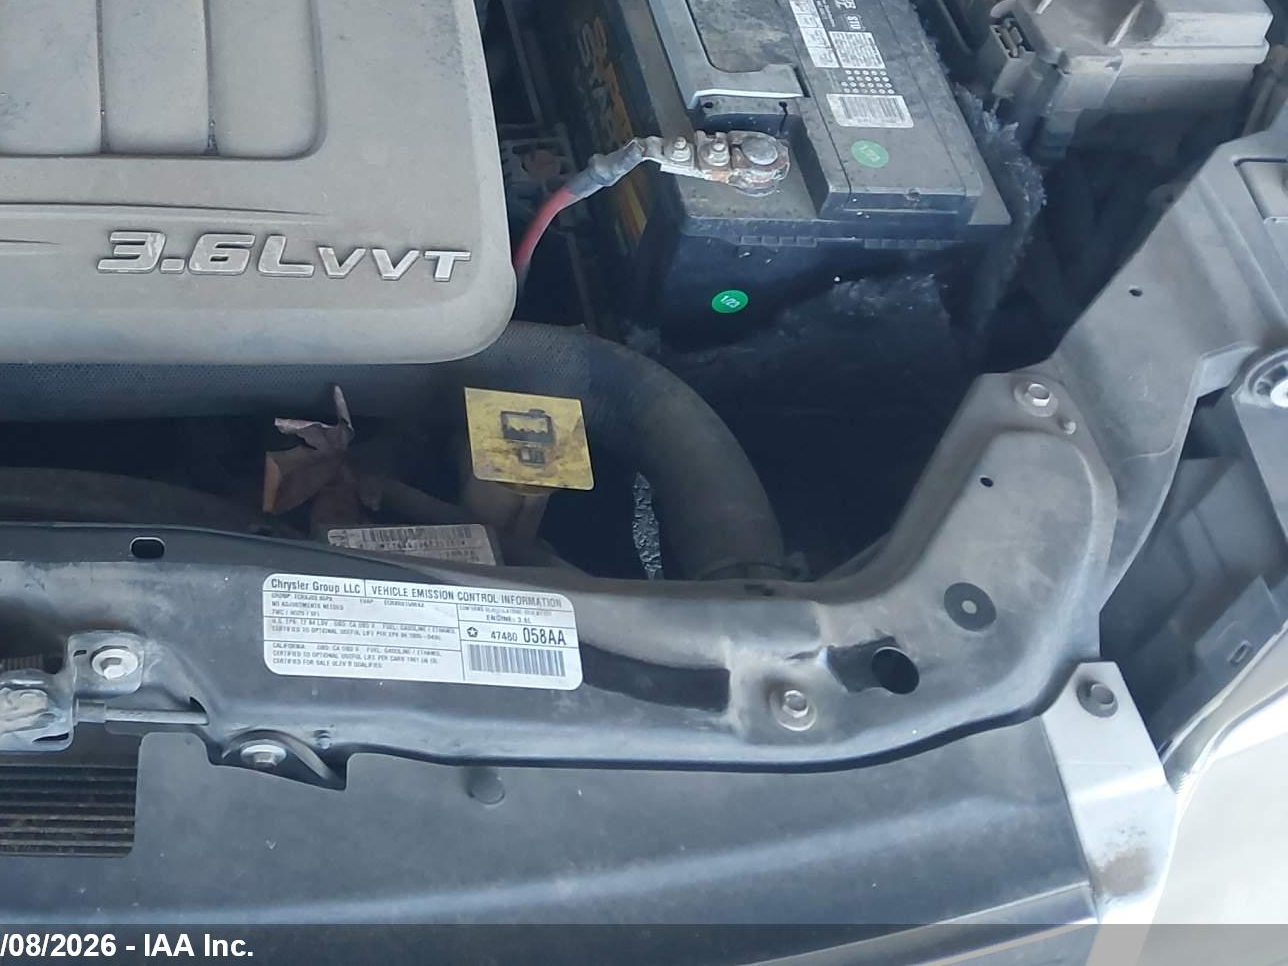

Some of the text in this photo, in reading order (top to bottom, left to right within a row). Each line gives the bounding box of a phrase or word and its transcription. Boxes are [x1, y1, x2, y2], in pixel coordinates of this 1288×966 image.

[719, 295, 741, 309] 1/23
[270, 578, 361, 594] Chrysler Group LLC
[371, 585, 562, 608] VEHICLE EMISSION CONTROL INFORMATION
[490, 626, 567, 646] 47480 058AA
